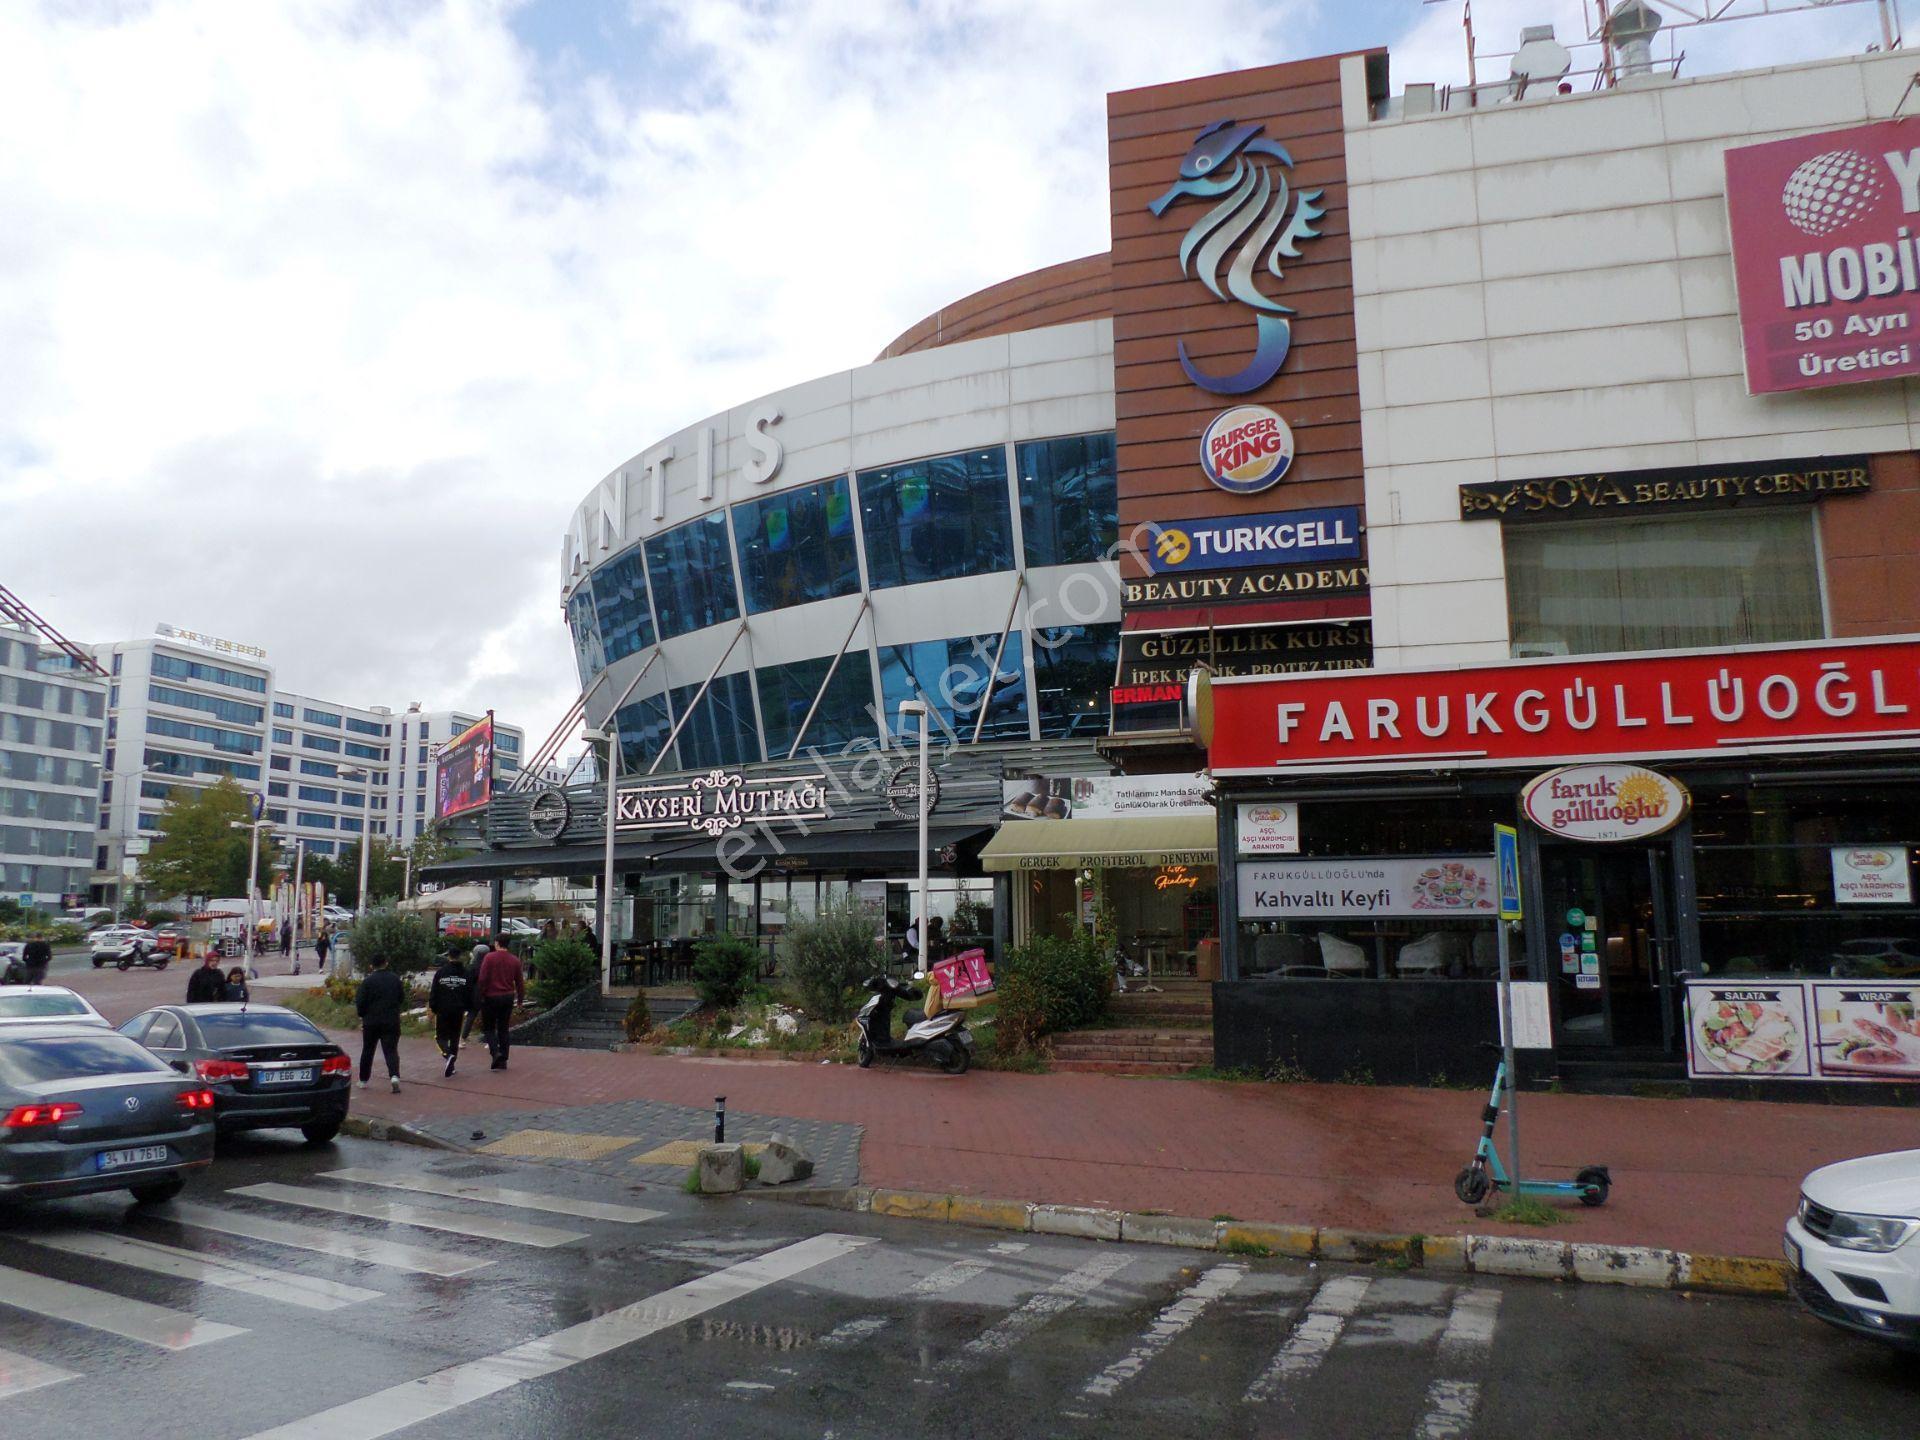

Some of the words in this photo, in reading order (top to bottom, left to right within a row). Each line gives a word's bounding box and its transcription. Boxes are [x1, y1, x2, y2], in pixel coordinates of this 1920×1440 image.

[1780, 226, 1920, 308] MOBİ
[1795, 319, 1833, 341] 50
[1844, 314, 1908, 336] Ayrı
[1798, 345, 1911, 376] Üretici
[1211, 418, 1277, 455] BURGER
[1214, 432, 1281, 478] KING
[1524, 476, 1631, 511] SOVA
[1634, 478, 1748, 502] BEAUTY
[1754, 468, 1871, 494] CENTER
[1193, 520, 1353, 555] TURKCELL
[1127, 577, 1233, 602] BEAUTY
[1141, 632, 1278, 658] GÜZELLİK
[1132, 668, 1172, 684] İPEK
[1324, 658, 1374, 671] TIRN
[1113, 685, 1182, 703] ERMAN
[1277, 662, 1920, 743] FARUKGÜLLÜOĞL
[1550, 775, 1618, 799] faruk
[616, 791, 702, 820] KAYSERİ
[714, 783, 826, 814] MUTFAĞI
[1115, 800, 1141, 809] Günlük
[1143, 800, 1168, 808] Olarak
[1552, 797, 1665, 828] güllüoğlu
[1020, 857, 1060, 869] GERÇEK
[1255, 890, 1334, 907] Kahvaltı
[1341, 890, 1390, 911] Keyfi
[1724, 991, 1767, 1001] SALATA
[1859, 992, 1893, 1001] WRAP
[301, 1070, 311, 1080] 22
[106, 1152, 118, 1165] 34
[140, 1147, 165, 1161] 7616
